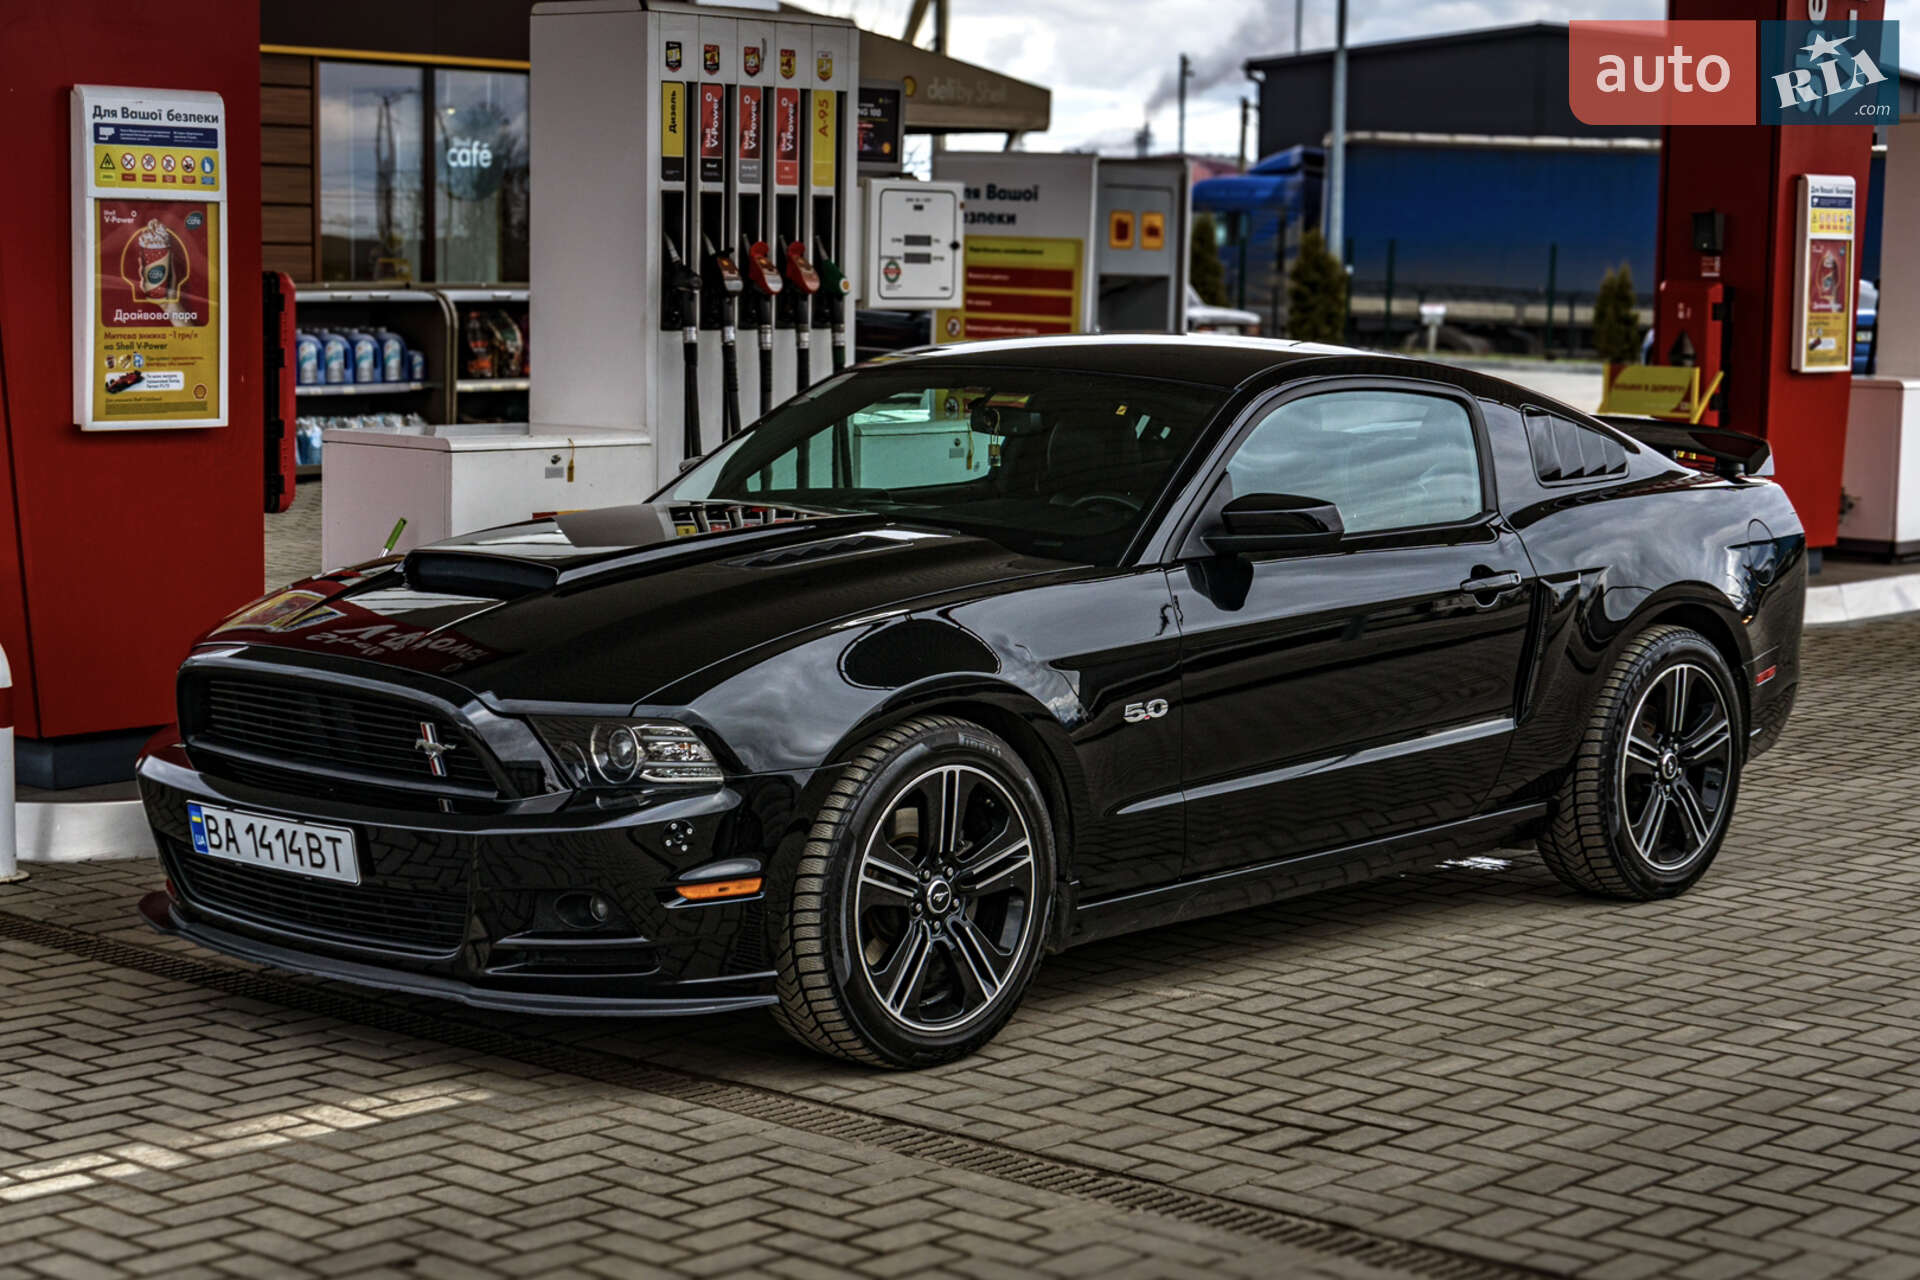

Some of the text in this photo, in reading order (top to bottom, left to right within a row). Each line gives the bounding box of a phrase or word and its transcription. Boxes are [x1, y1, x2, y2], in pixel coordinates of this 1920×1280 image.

[92, 105, 219, 124] Для Вашої безпеки
[668, 89, 677, 134] Дизель
[711, 97, 719, 148] V-Power
[749, 100, 757, 149] V-Power
[786, 103, 794, 151] V-Power
[447, 140, 493, 168] café
[986, 183, 1040, 201] Вашої
[113, 309, 198, 323] Драйвова пара
[115, 342, 134, 350] Shell
[136, 342, 168, 350] V-Power
[1123, 698, 1168, 722] 5.0
